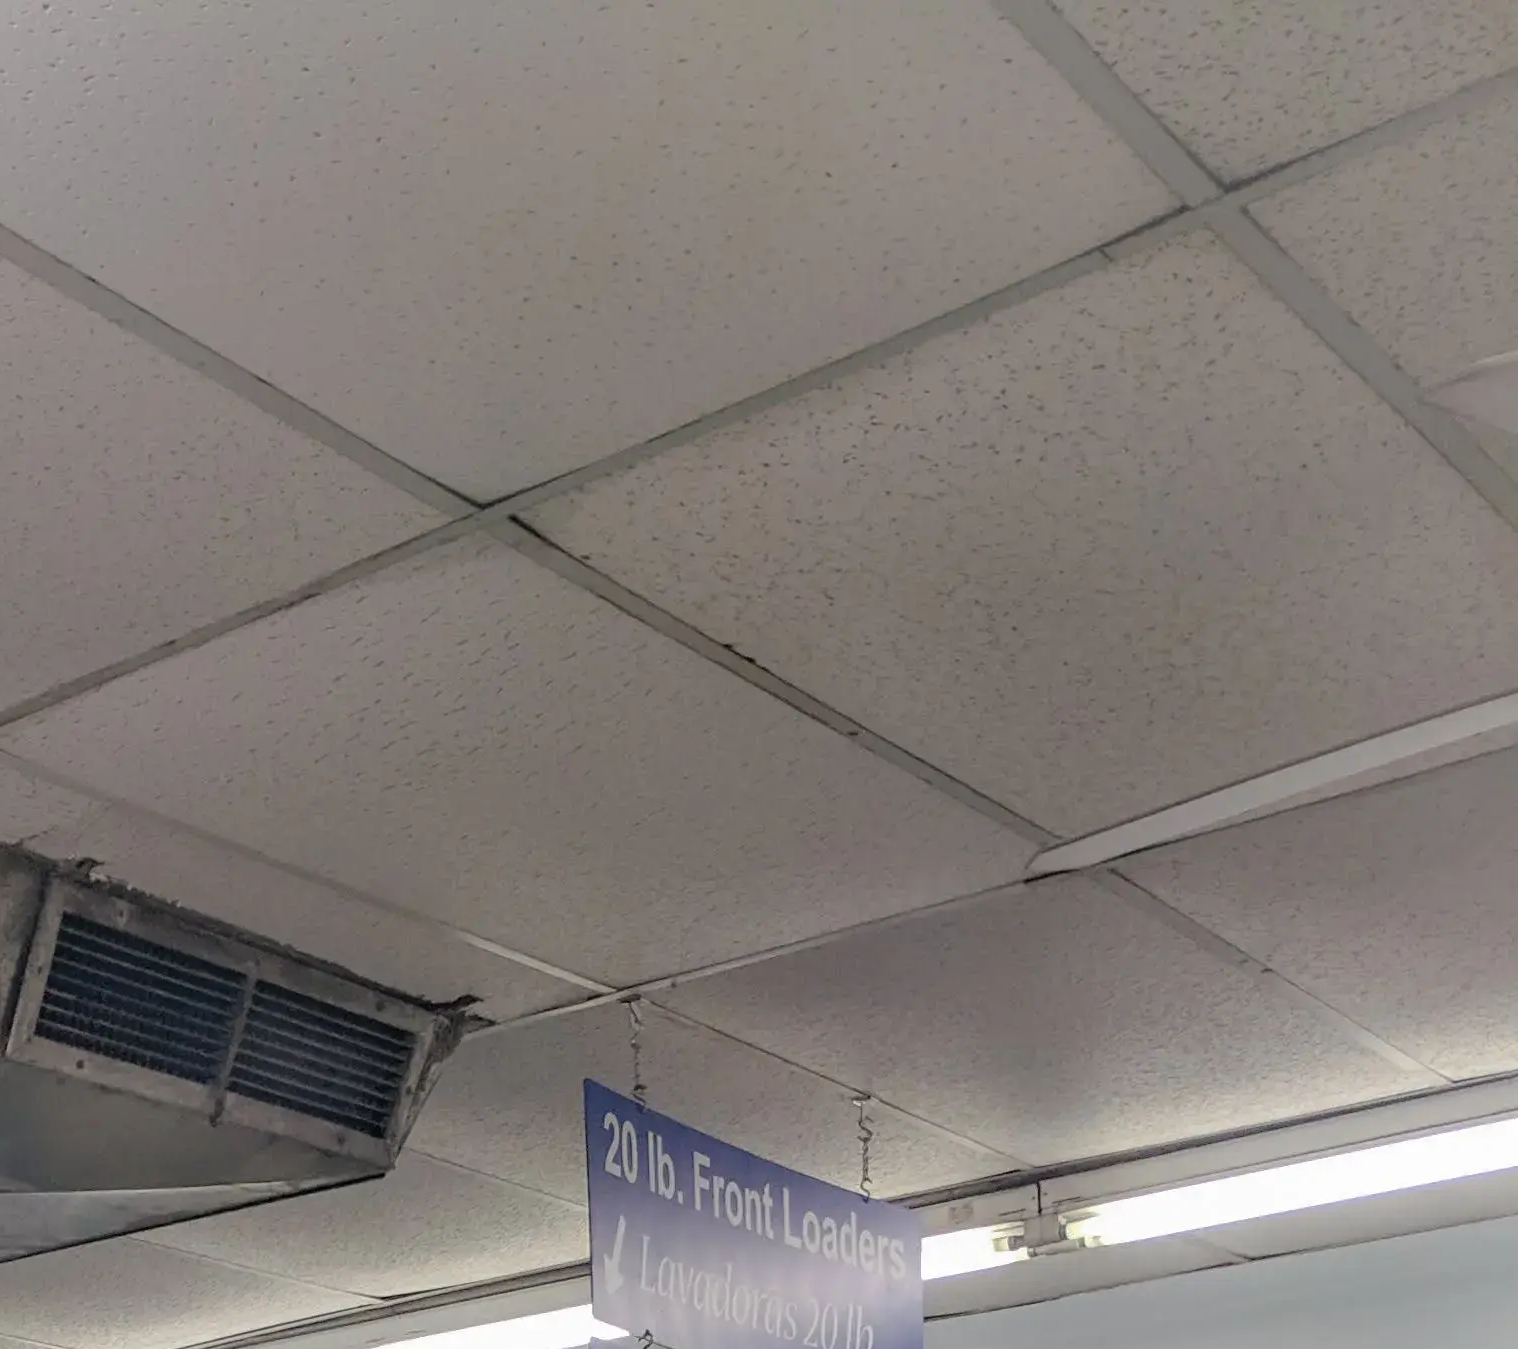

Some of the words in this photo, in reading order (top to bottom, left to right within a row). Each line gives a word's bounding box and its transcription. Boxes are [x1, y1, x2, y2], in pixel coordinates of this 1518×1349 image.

[602, 1112, 638, 1184] 20
[648, 1130, 683, 1204] lb.
[694, 1152, 774, 1239] Front
[783, 1187, 906, 1281] Loaders
[641, 1235, 798, 1340] Lavadoras
